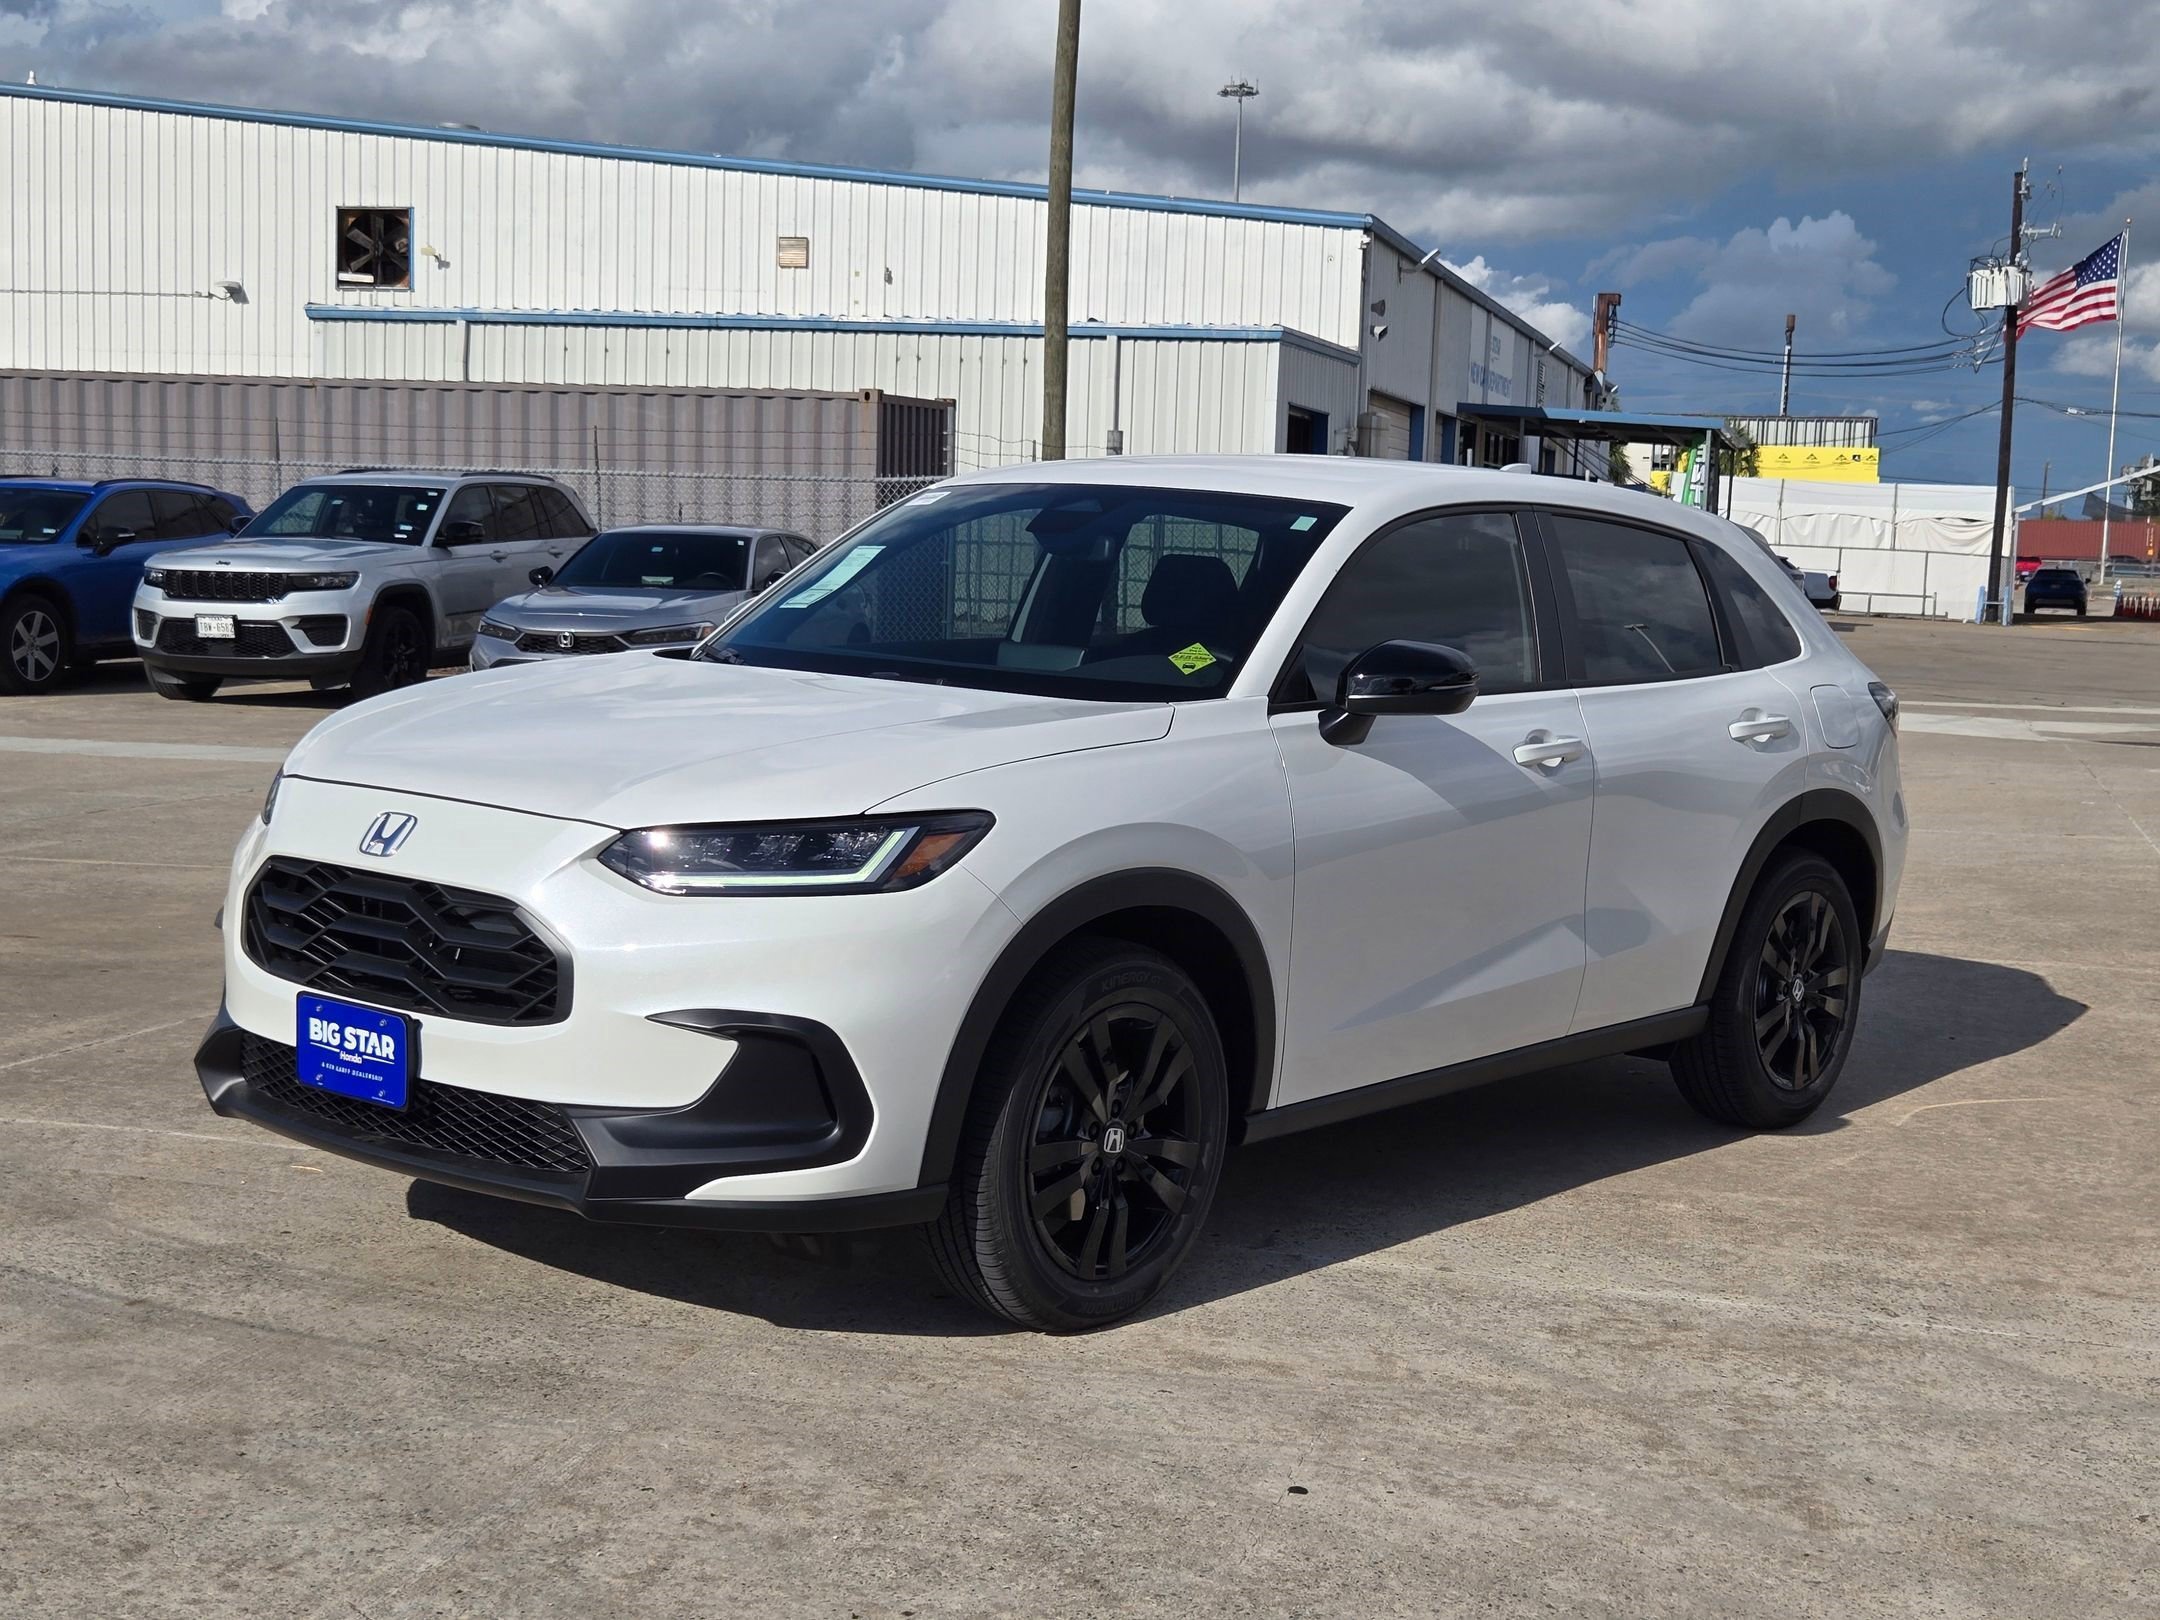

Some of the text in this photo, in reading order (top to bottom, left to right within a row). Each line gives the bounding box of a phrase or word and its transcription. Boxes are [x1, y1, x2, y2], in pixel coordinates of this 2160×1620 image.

[309, 1017, 395, 1060] BIG STAR
[339, 1050, 363, 1064] Honda
